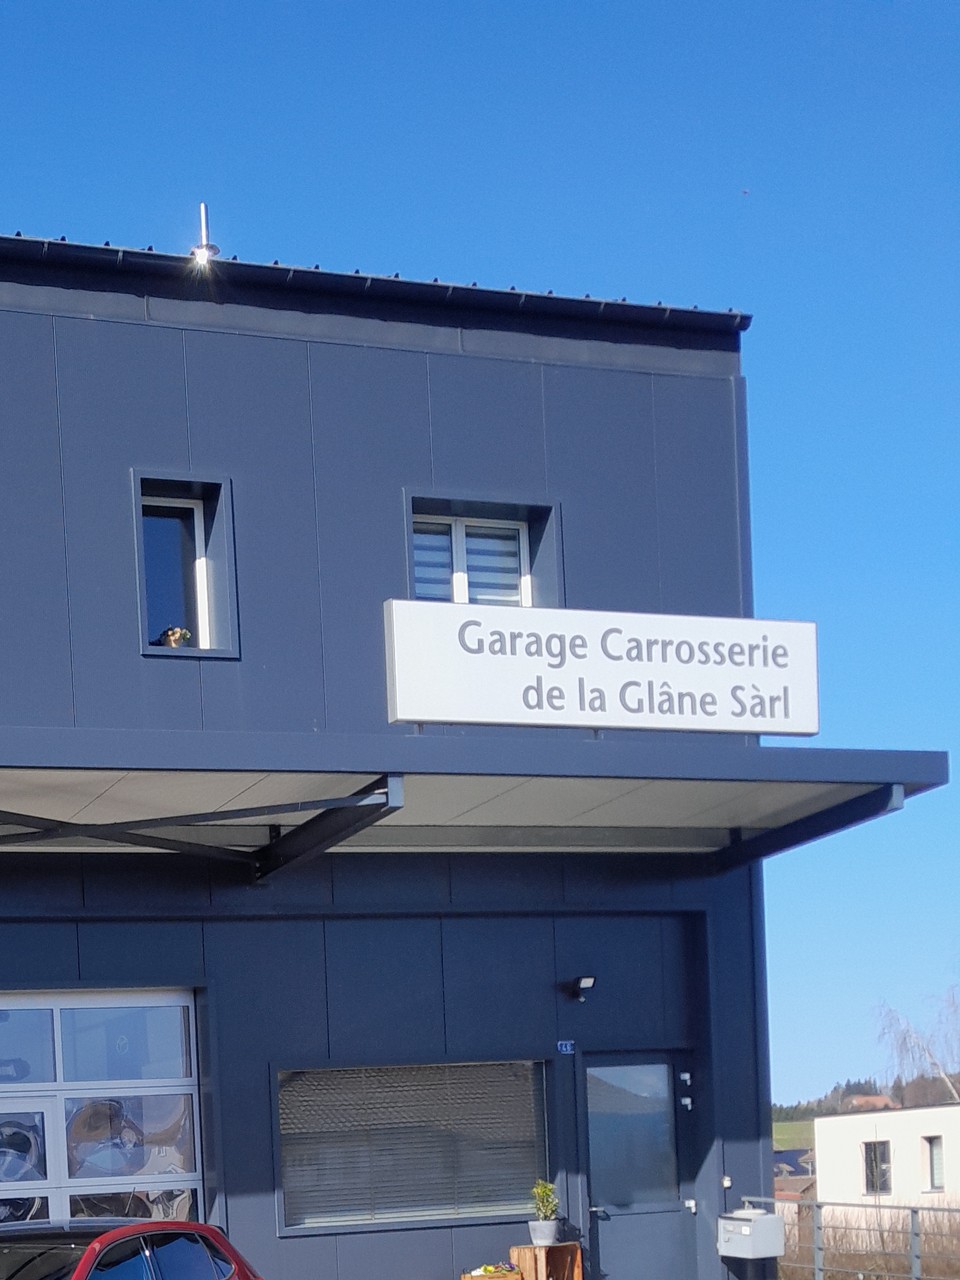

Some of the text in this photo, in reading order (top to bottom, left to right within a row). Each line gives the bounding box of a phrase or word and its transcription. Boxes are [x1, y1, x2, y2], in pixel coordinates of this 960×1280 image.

[458, 620, 789, 669] Garage Carrosserie
[522, 675, 791, 719] de la Glâne Sàrl
